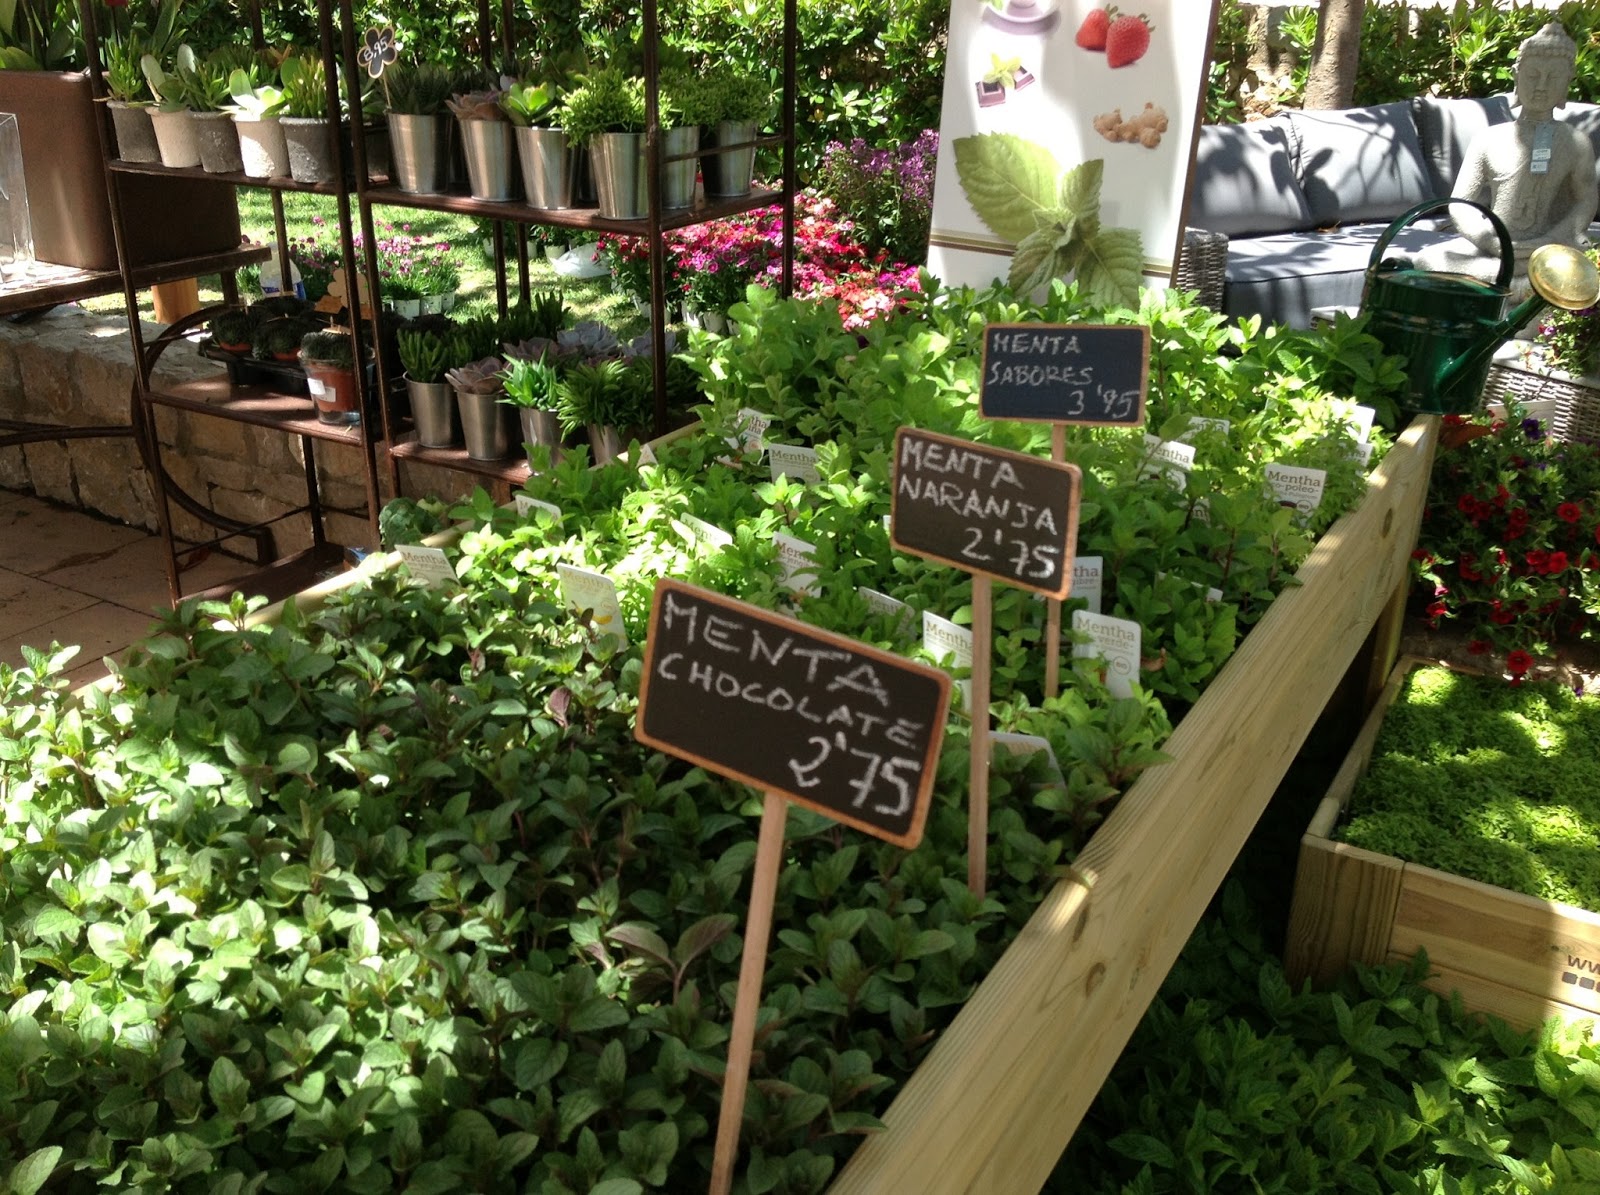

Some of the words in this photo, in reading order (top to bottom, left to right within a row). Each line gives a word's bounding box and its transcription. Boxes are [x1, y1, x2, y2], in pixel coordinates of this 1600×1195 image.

[363, 36, 388, 61] 8,95
[993, 332, 1081, 355] MENTA
[987, 361, 1094, 386] SABORES
[770, 449, 817, 463] Mentha
[901, 437, 1025, 489] MENTA
[1268, 470, 1321, 488] Mentha
[900, 474, 1058, 536] NARANJA
[961, 527, 1060, 579] 2'75
[1077, 617, 1135, 641] Mentha
[664, 593, 889, 707] MENTA
[657, 653, 923, 749] CHOCOLATE
[788, 731, 921, 816] 2'75
